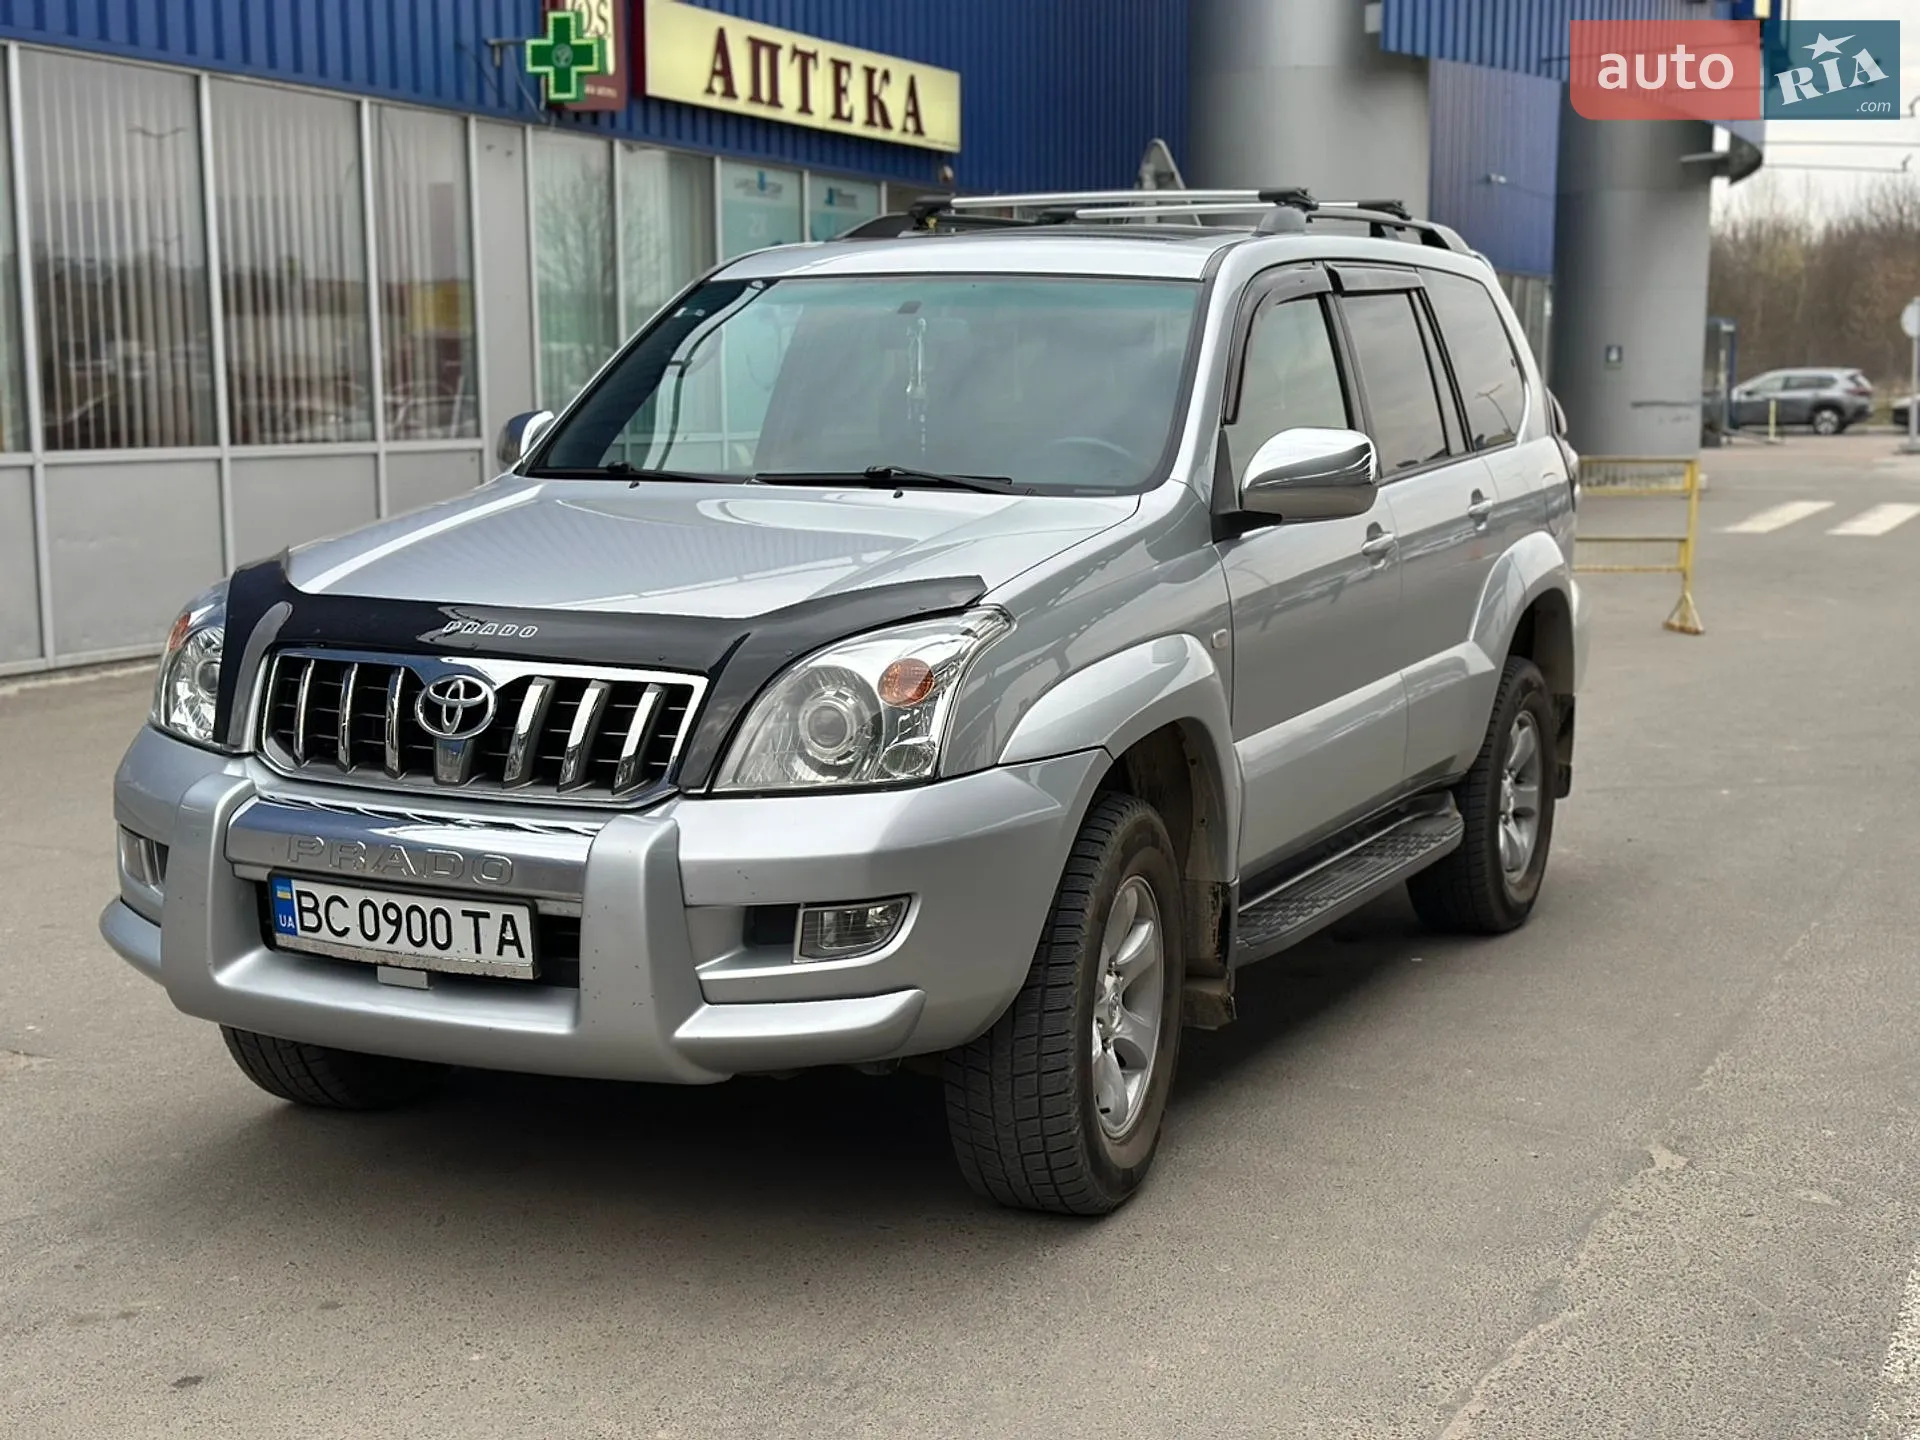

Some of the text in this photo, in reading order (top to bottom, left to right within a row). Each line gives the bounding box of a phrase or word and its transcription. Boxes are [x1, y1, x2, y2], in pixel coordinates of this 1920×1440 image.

[705, 27, 926, 137] АПТЕКА
[441, 620, 538, 638] PRADO
[287, 834, 514, 885] PRADO
[279, 915, 295, 928] UA
[297, 889, 525, 959] BC 0900 TA
